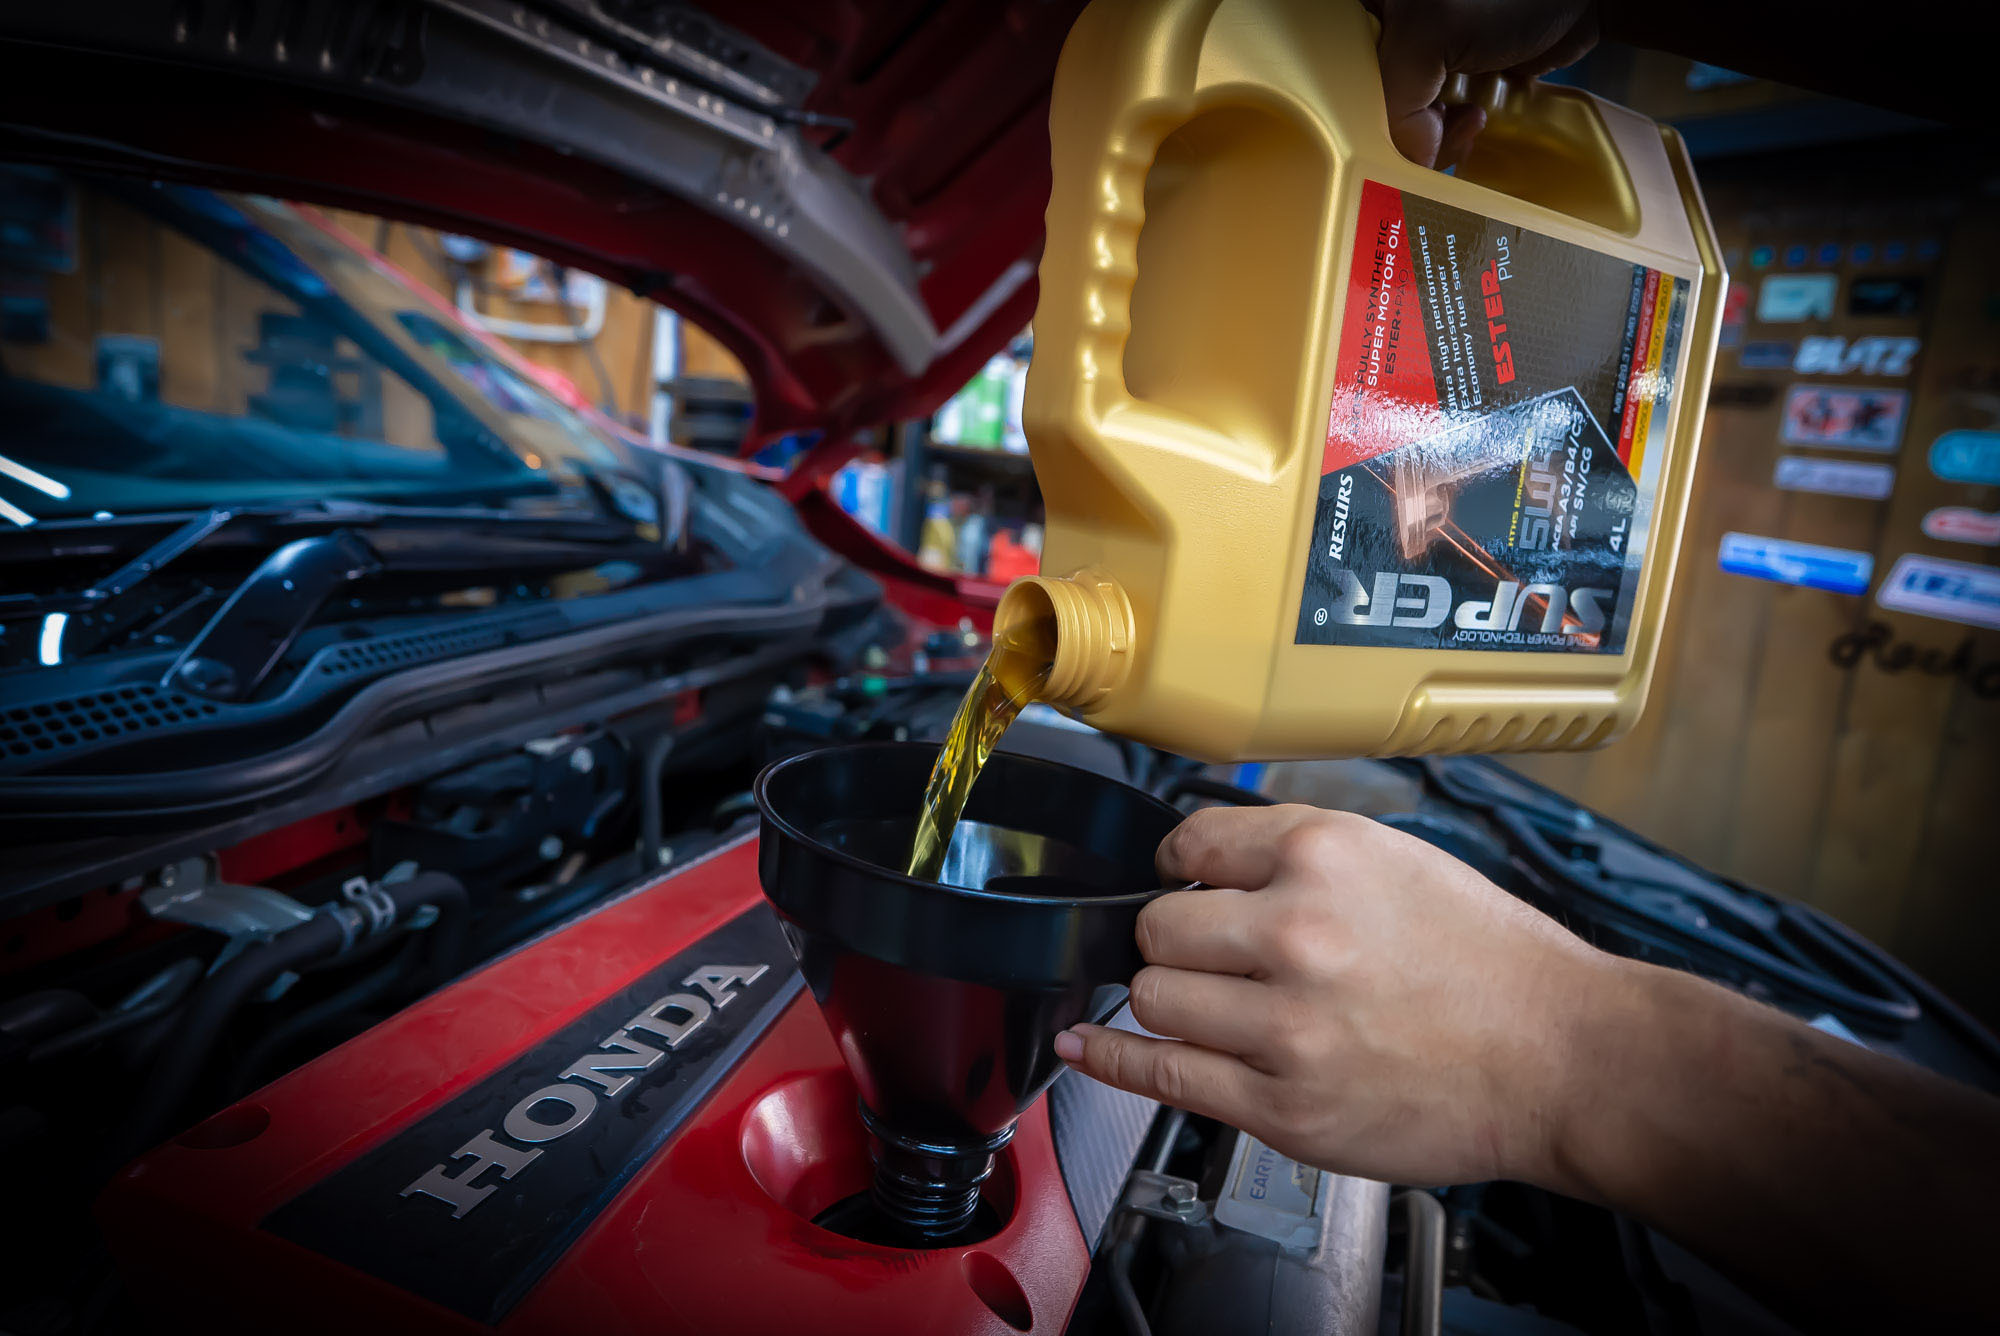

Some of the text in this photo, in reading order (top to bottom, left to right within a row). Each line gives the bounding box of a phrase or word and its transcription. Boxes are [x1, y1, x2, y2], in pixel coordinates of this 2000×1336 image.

[1357, 328, 1373, 384] FULLY
[1366, 219, 1389, 323] SYNTHETIC
[1367, 219, 1402, 386] SUPER MOTOR OIL
[1417, 225, 1459, 413] Ultra high performance
[1445, 234, 1482, 406] Economy fuel saving
[1481, 259, 1516, 385] ESTER
[1496, 235, 1513, 281] Plus
[1436, 264, 1471, 410] Extra horsepower
[1328, 473, 1355, 560] RESURS
[1518, 399, 1566, 551] 5W4
[1552, 411, 1584, 551] ACEA A3/B4/C3
[1569, 446, 1593, 538] API SN/CG
[1609, 517, 1627, 552] 4L
[1330, 569, 1614, 635] SUPER
[1451, 630, 1526, 644] TECHNOLOGY
[1526, 633, 1566, 646] POWER
[399, 963, 769, 1220] HONDA
